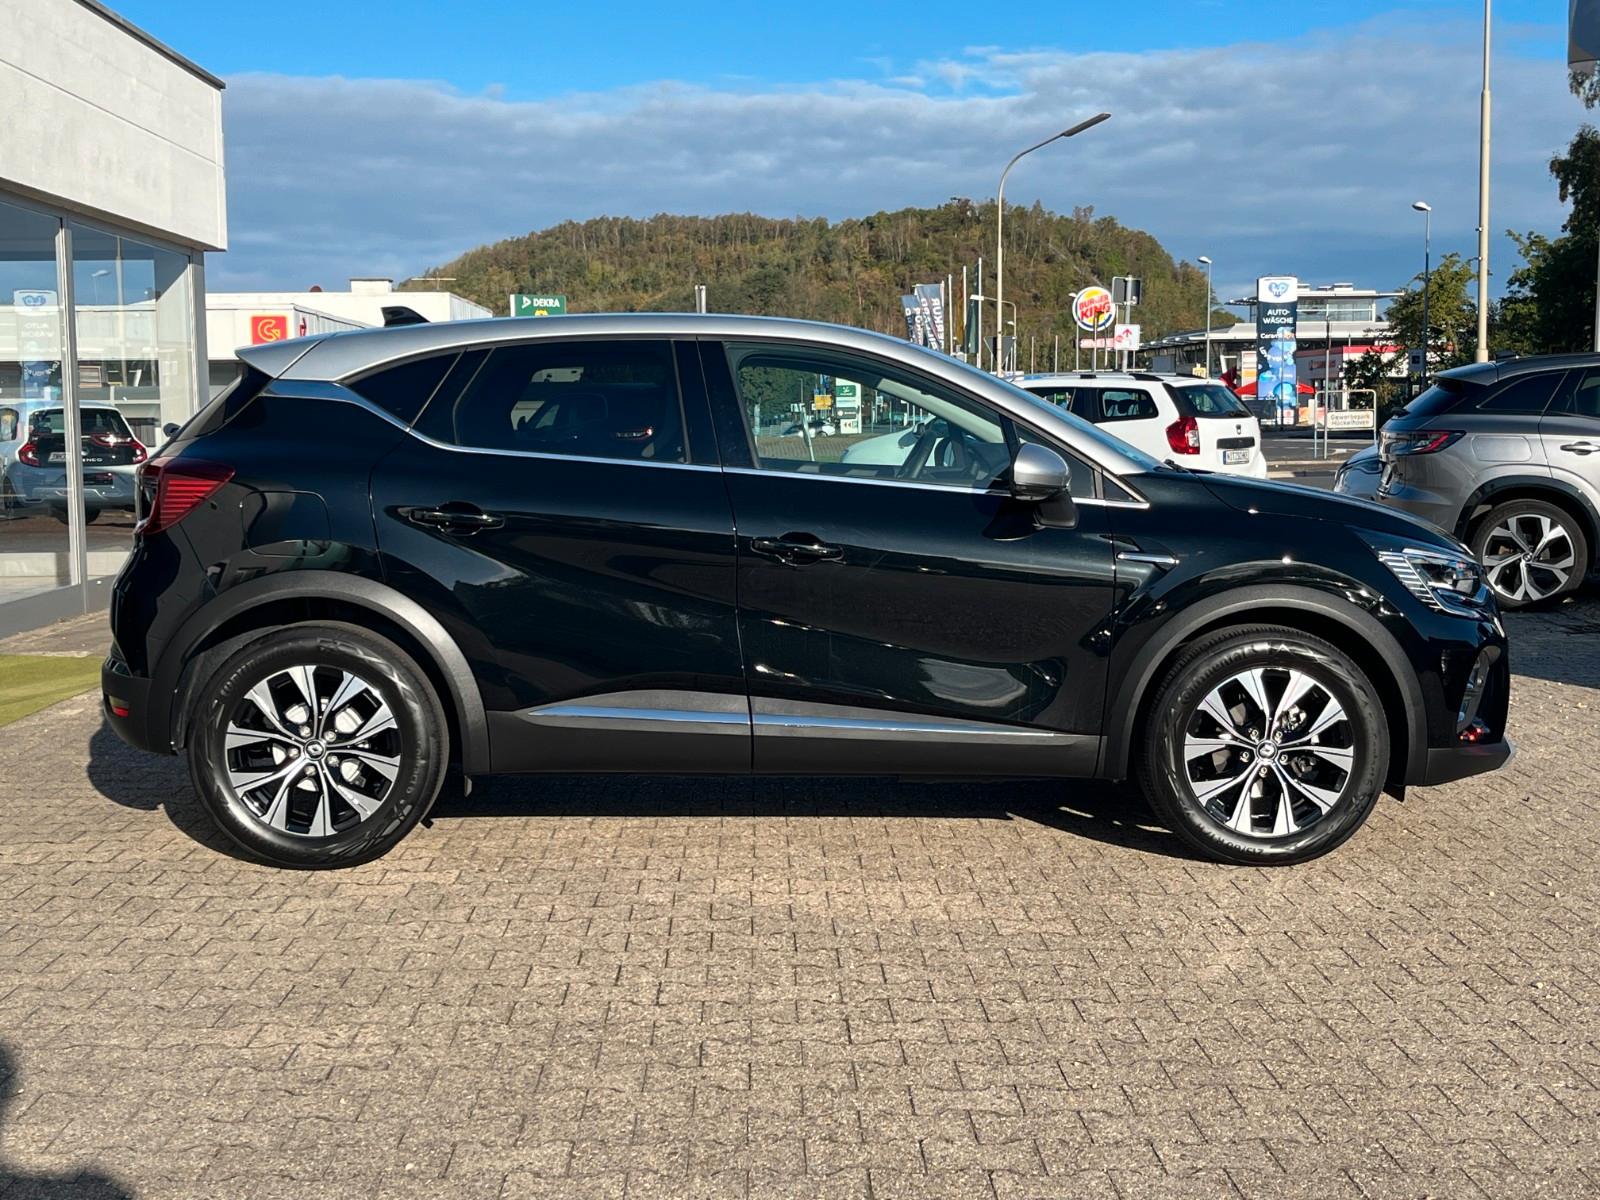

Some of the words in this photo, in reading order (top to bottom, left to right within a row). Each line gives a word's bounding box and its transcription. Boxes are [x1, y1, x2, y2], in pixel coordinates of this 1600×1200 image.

[533, 298, 560, 307] DEKRA
[1079, 294, 1109, 310] BURGER
[1080, 301, 1111, 321] KING
